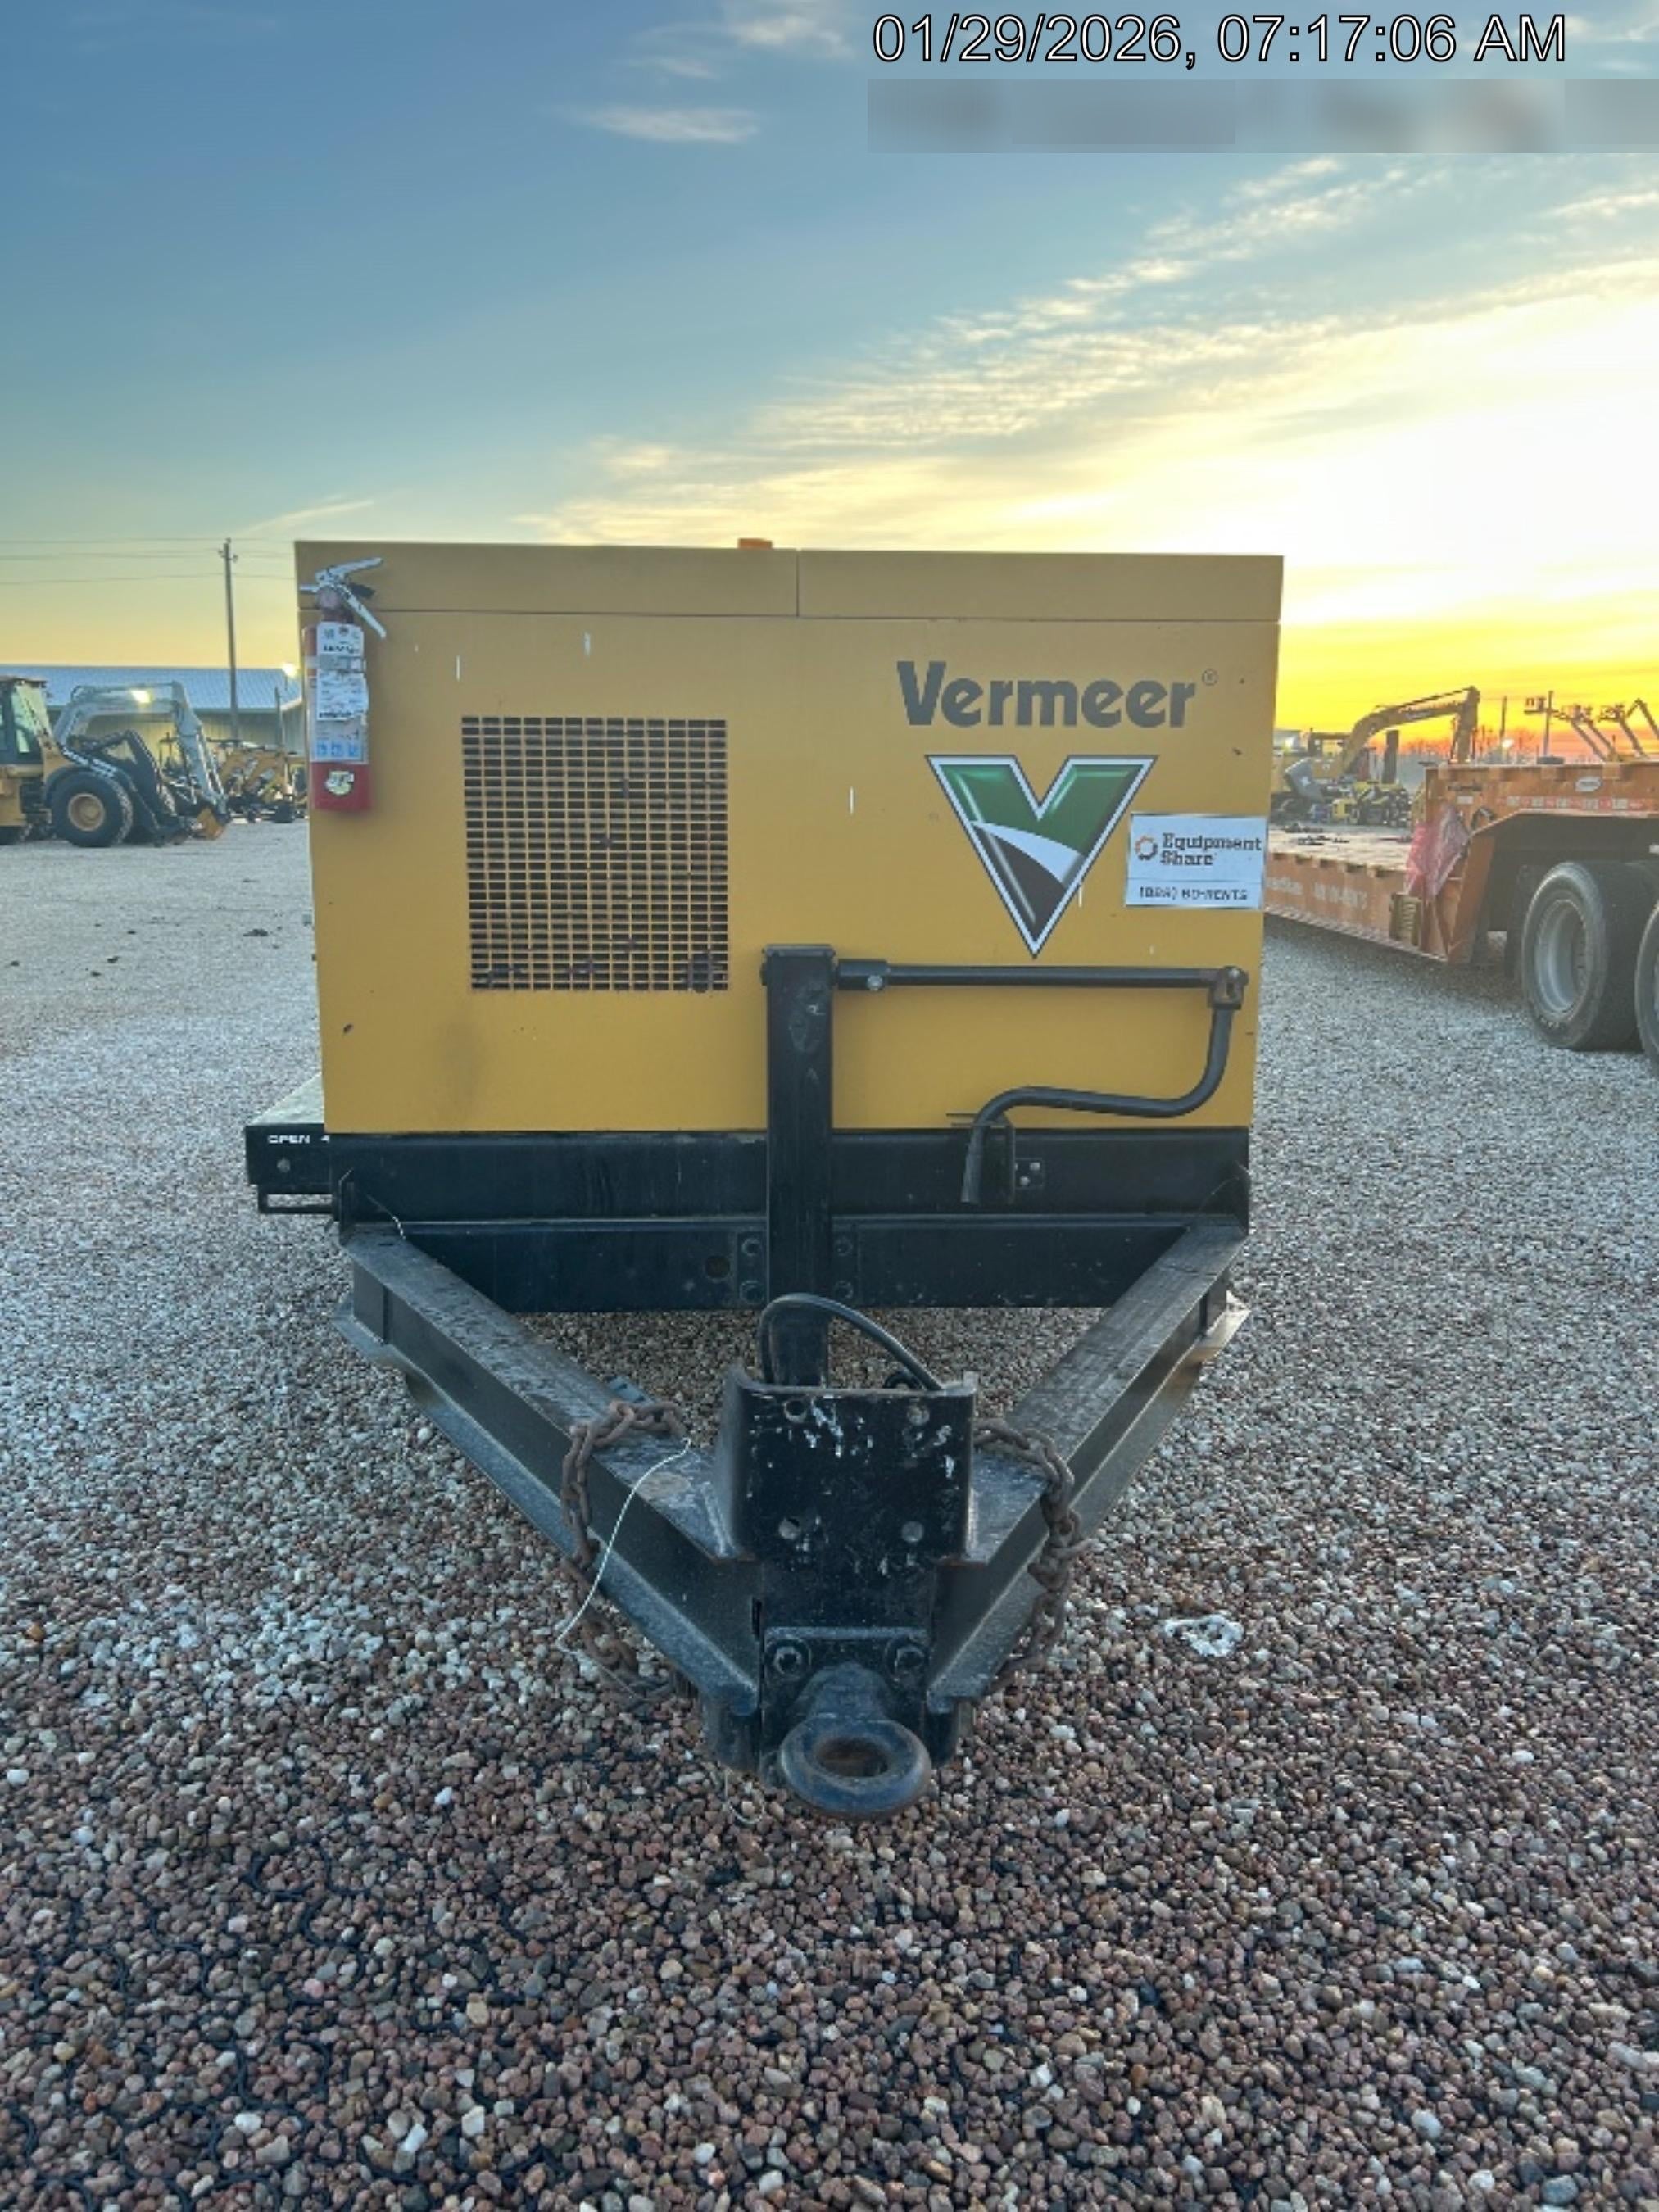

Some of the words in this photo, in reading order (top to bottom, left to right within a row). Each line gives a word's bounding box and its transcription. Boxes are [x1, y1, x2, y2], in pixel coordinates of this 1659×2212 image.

[896, 660, 1196, 728] Vermeer
[1161, 832, 1262, 852] Equipment
[1160, 850, 1213, 866] Share
[267, 1135, 310, 1144] OPEN
